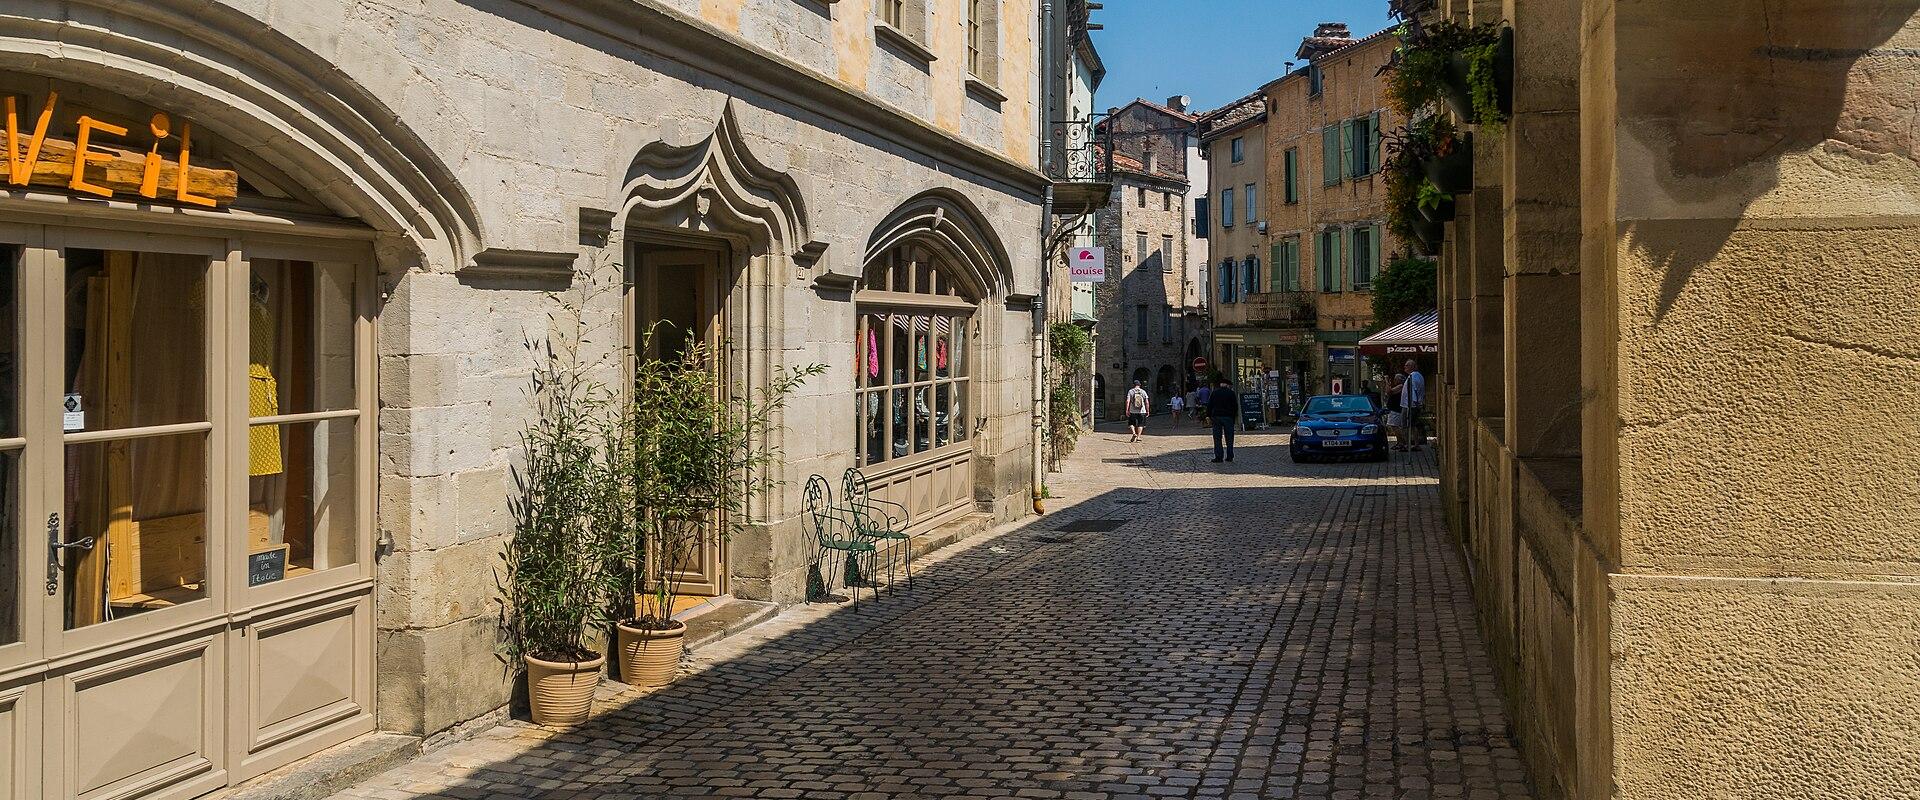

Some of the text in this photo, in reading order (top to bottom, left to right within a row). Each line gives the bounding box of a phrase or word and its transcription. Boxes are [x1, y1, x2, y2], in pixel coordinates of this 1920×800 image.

[1071, 266, 1103, 275] Louise
[1386, 345, 1416, 354] pizza
[260, 561, 270, 570] in
